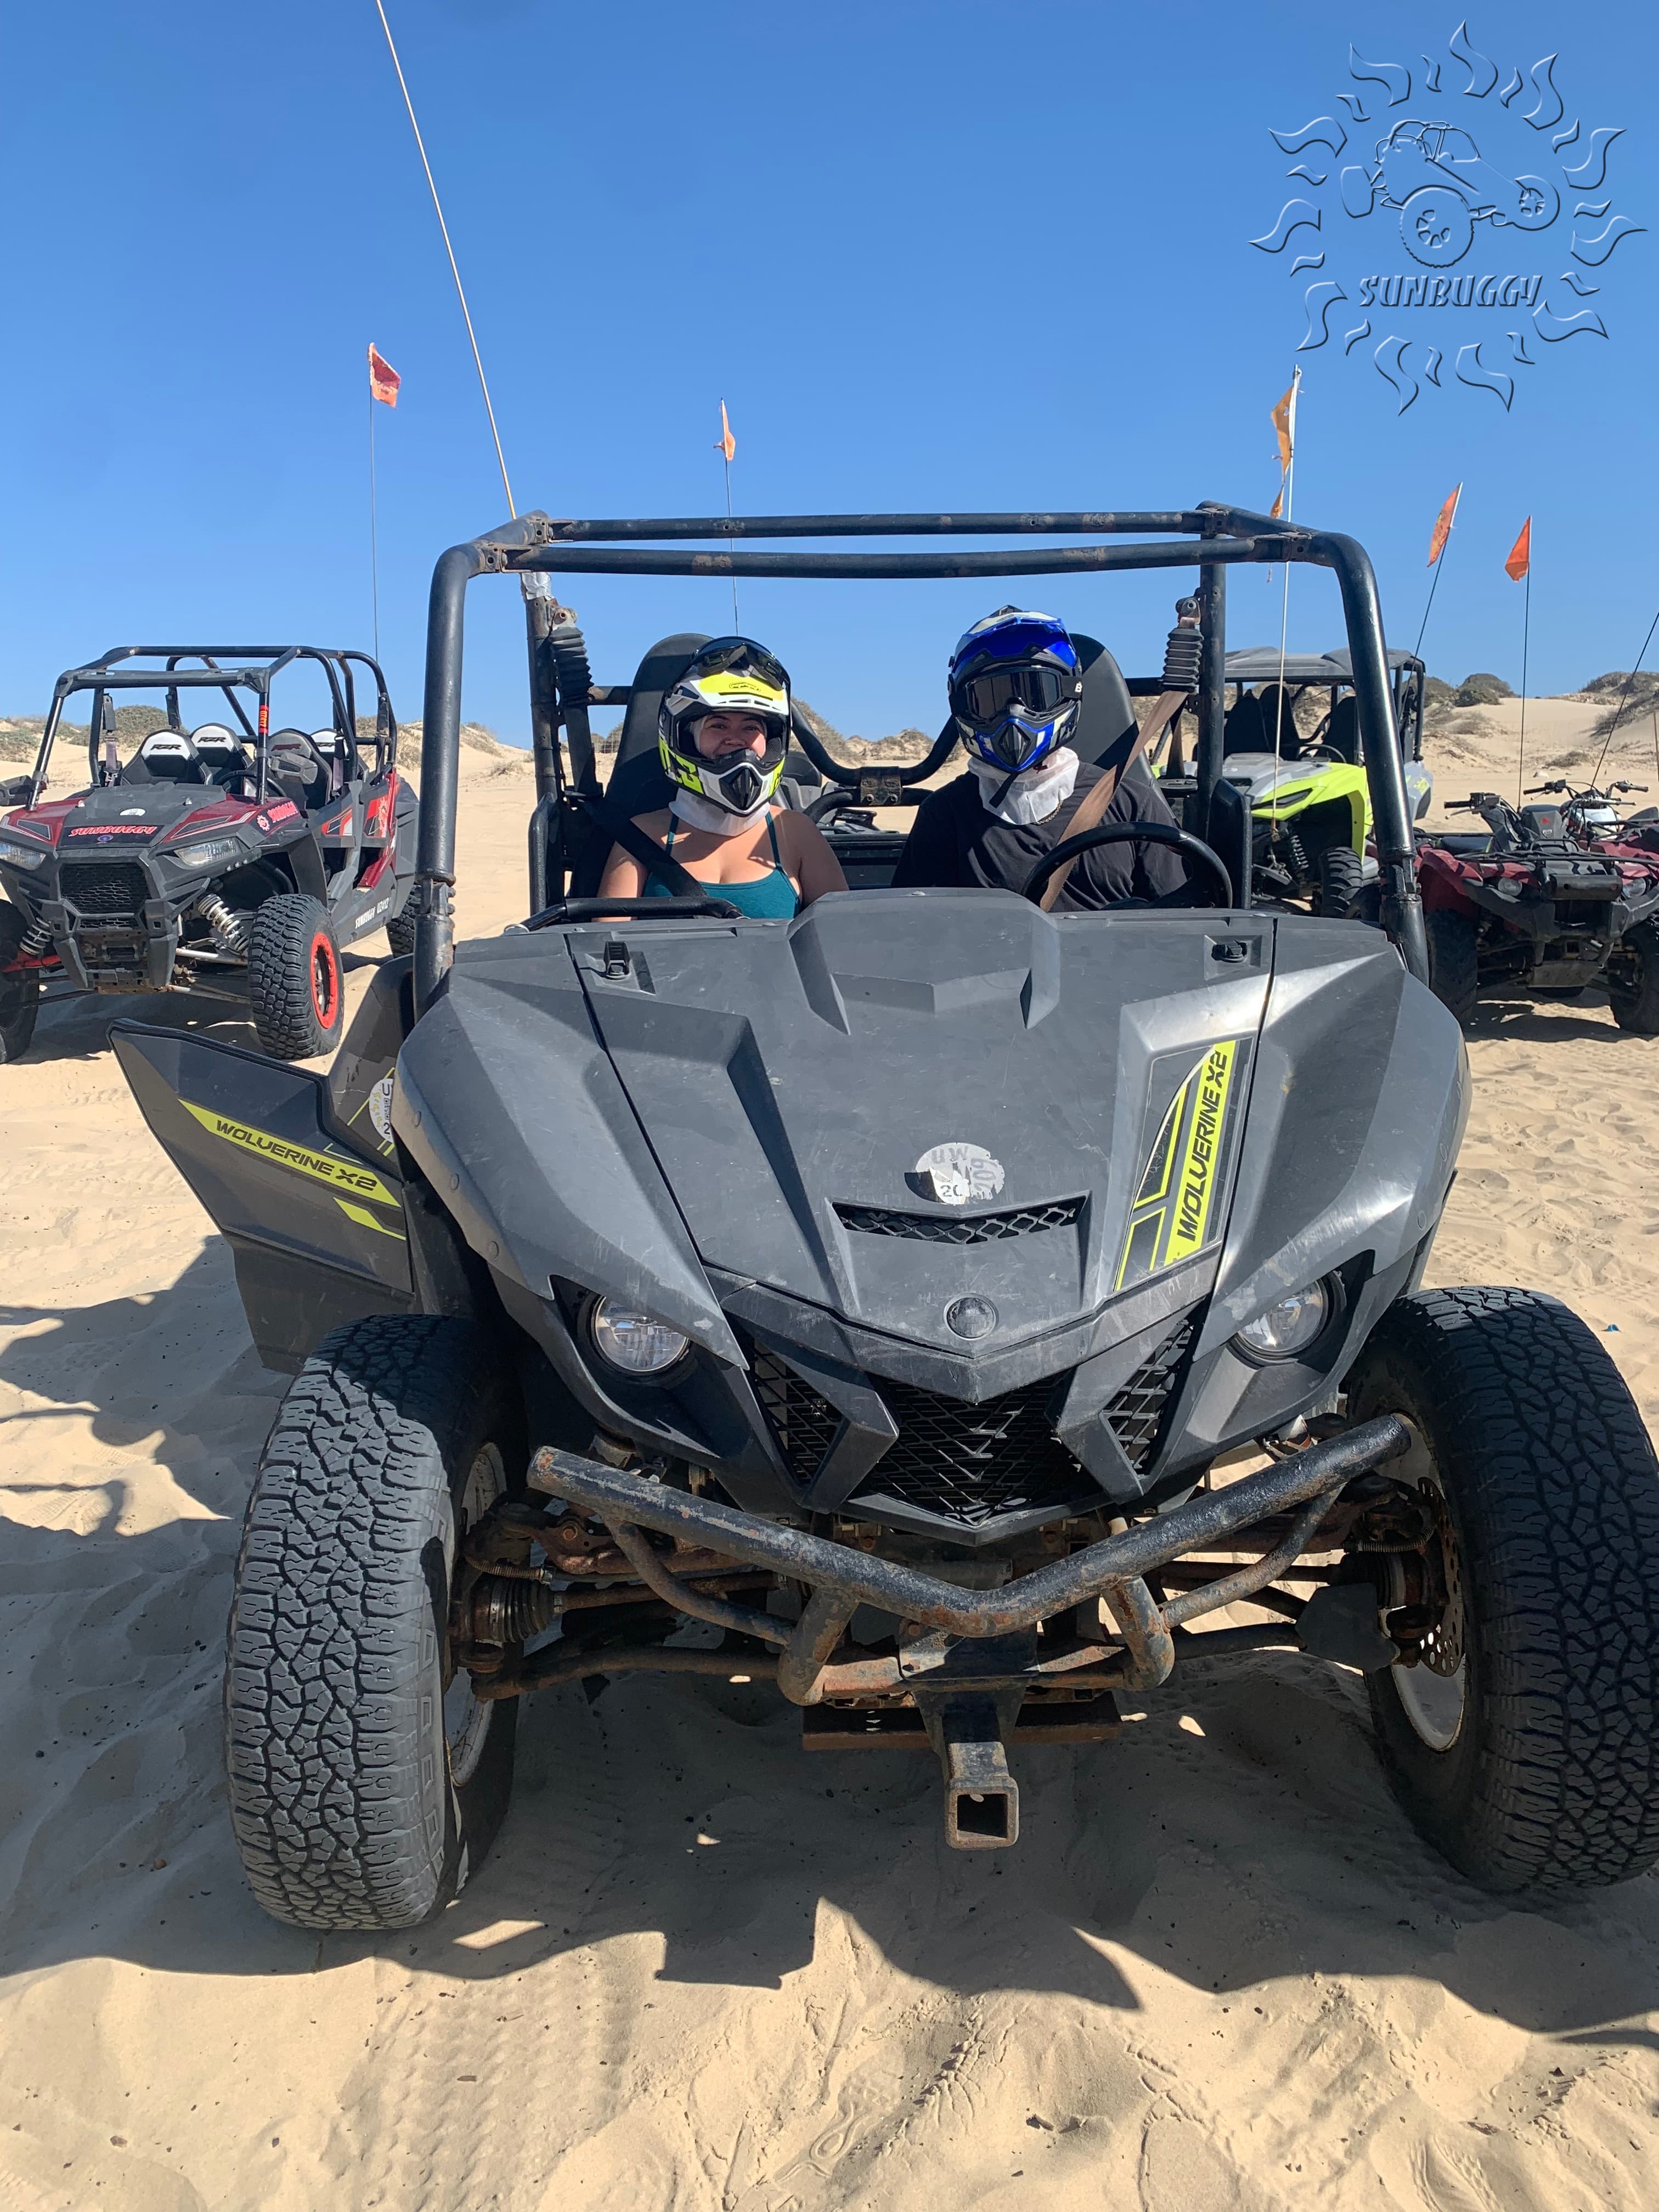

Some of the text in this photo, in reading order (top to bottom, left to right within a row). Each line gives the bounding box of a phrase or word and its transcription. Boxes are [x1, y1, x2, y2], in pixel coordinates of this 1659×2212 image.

[68, 826, 157, 837] SUNBUGGY
[216, 1120, 377, 1191] WOLVERINE X2
[1177, 1050, 1227, 1242] WOLVERINE X2
